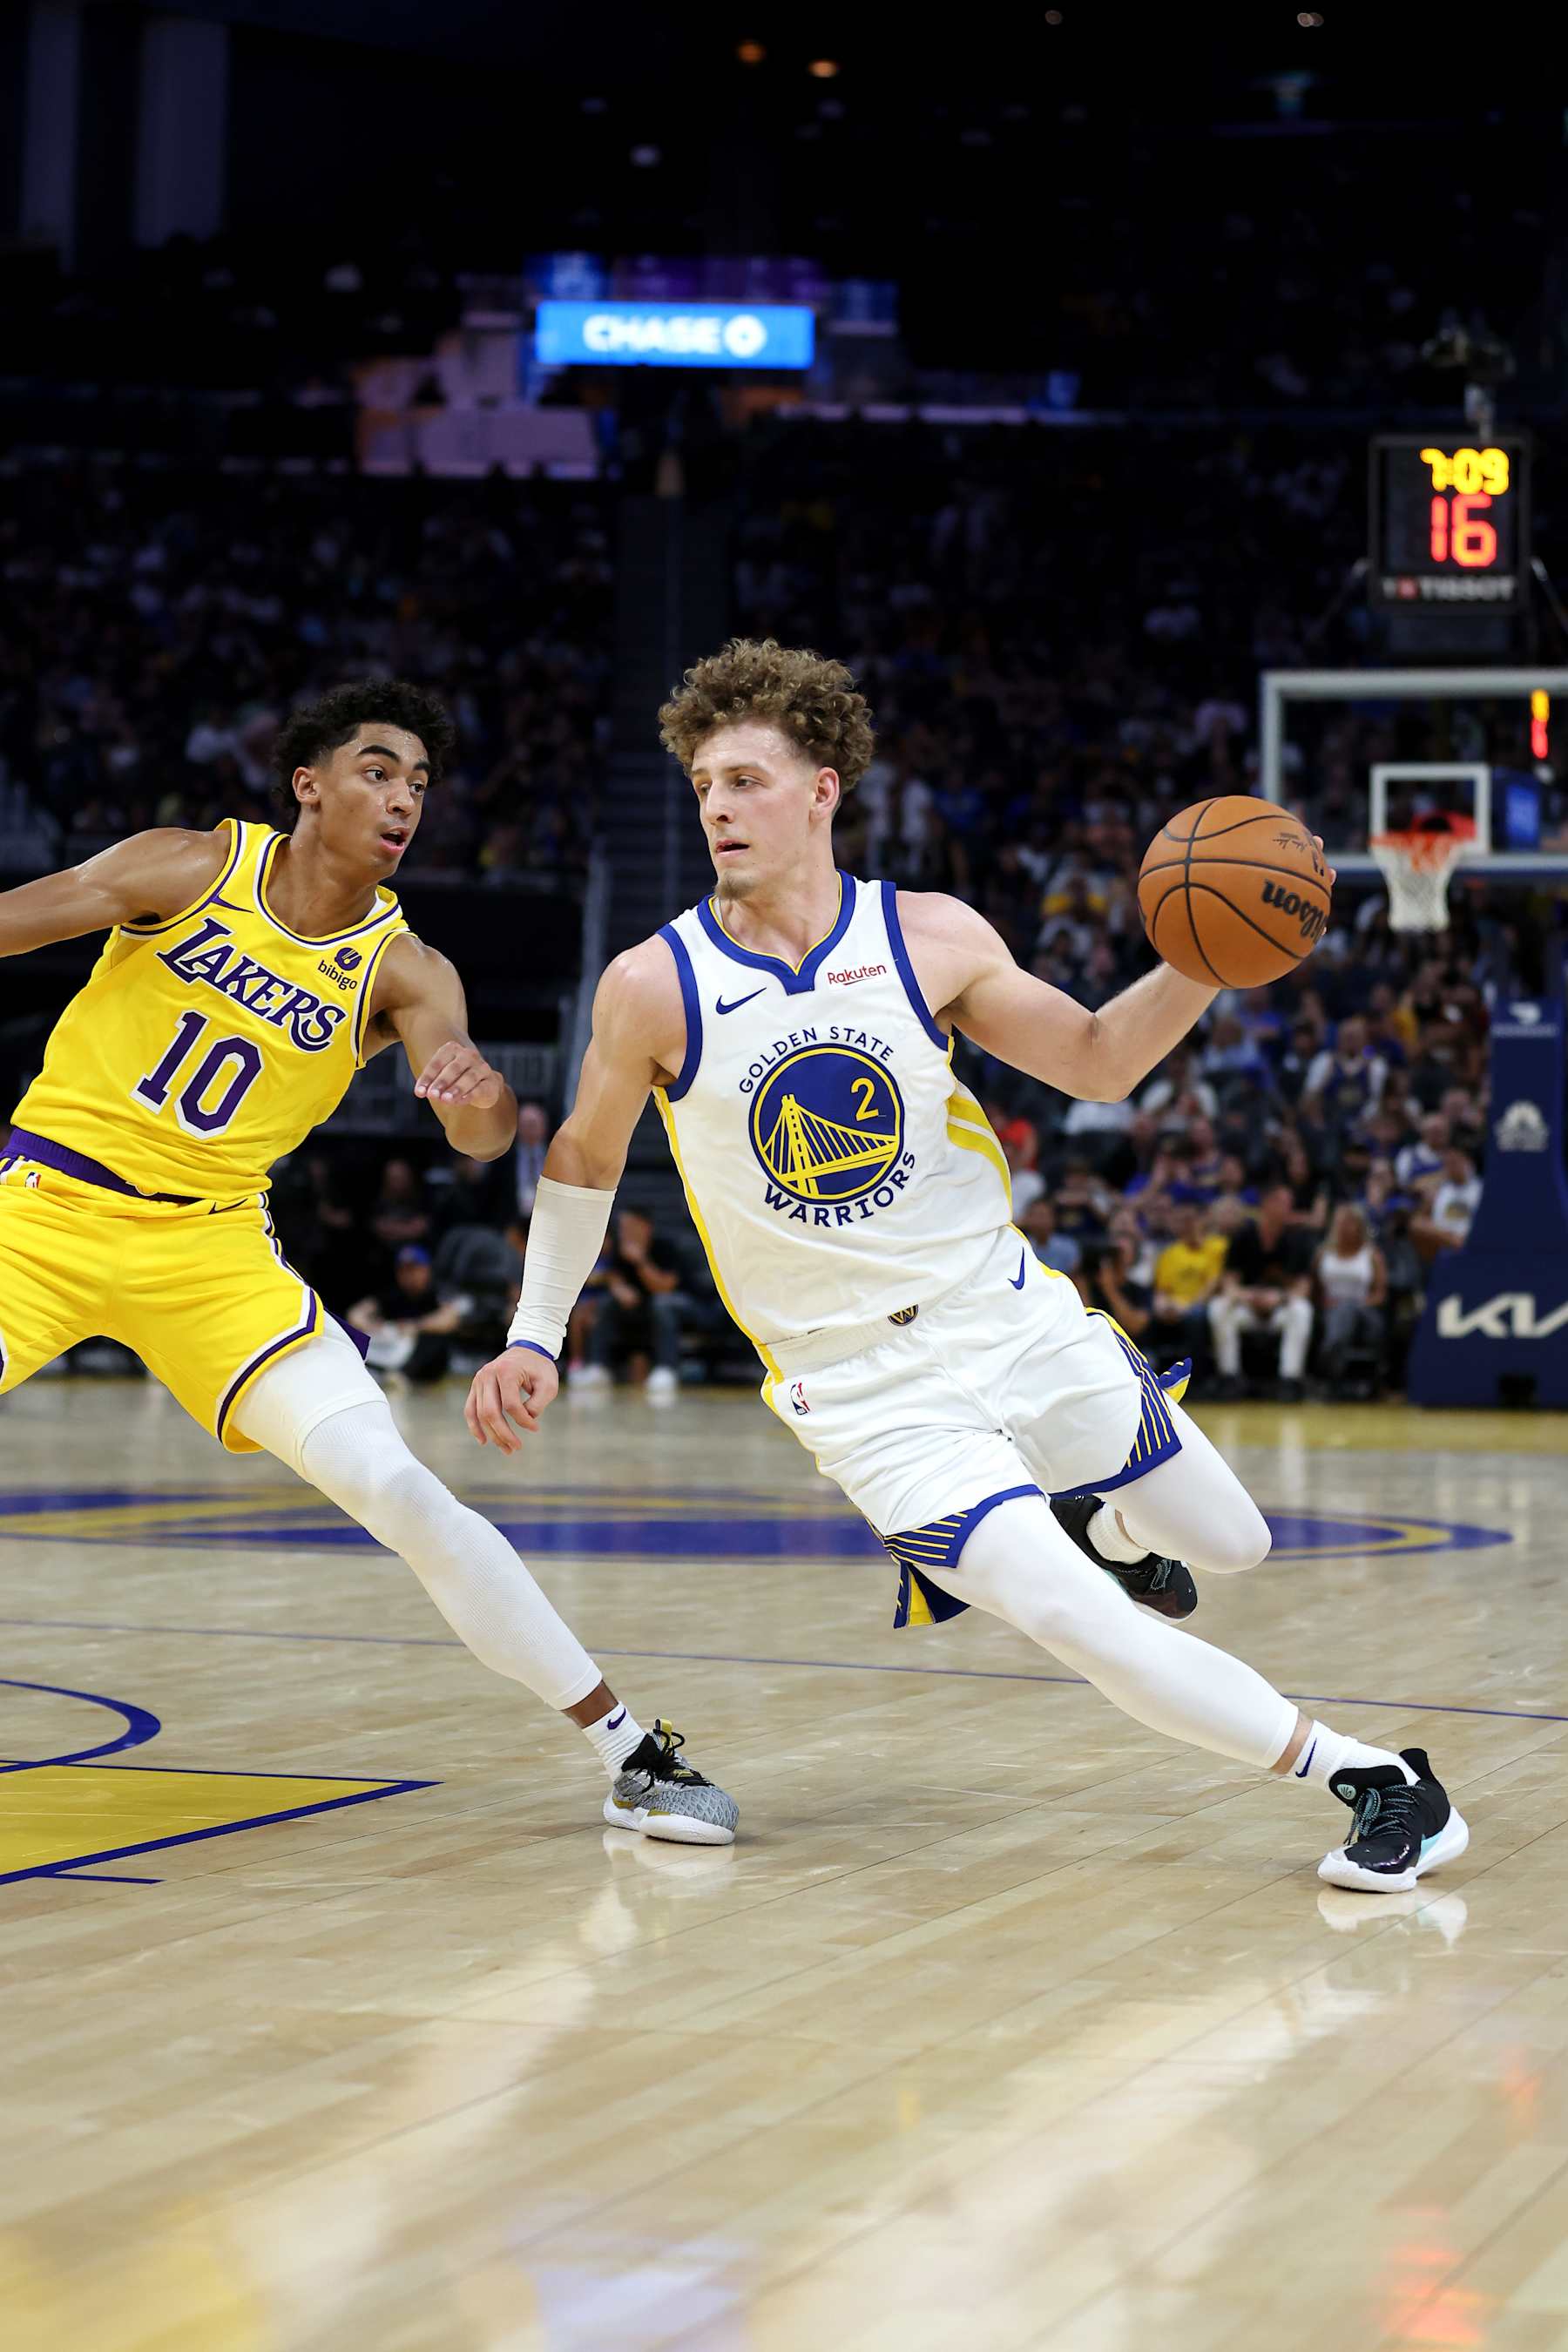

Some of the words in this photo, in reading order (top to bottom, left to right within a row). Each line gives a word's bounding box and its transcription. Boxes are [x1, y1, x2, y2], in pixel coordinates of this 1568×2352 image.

[583, 314, 724, 355] CHASE
[1420, 448, 1510, 496] 7:09
[1431, 492, 1497, 568] 16
[1261, 879, 1327, 944] ilson
[155, 916, 348, 1054] LAKERS
[317, 960, 359, 991] bibigo
[827, 963, 887, 986] Rakuten
[129, 1009, 265, 1140] 10
[739, 1026, 818, 1094] GOLDEN
[829, 1025, 894, 1062] STATE
[850, 1077, 880, 1122] 2
[763, 1151, 916, 1227] WARRIORS
